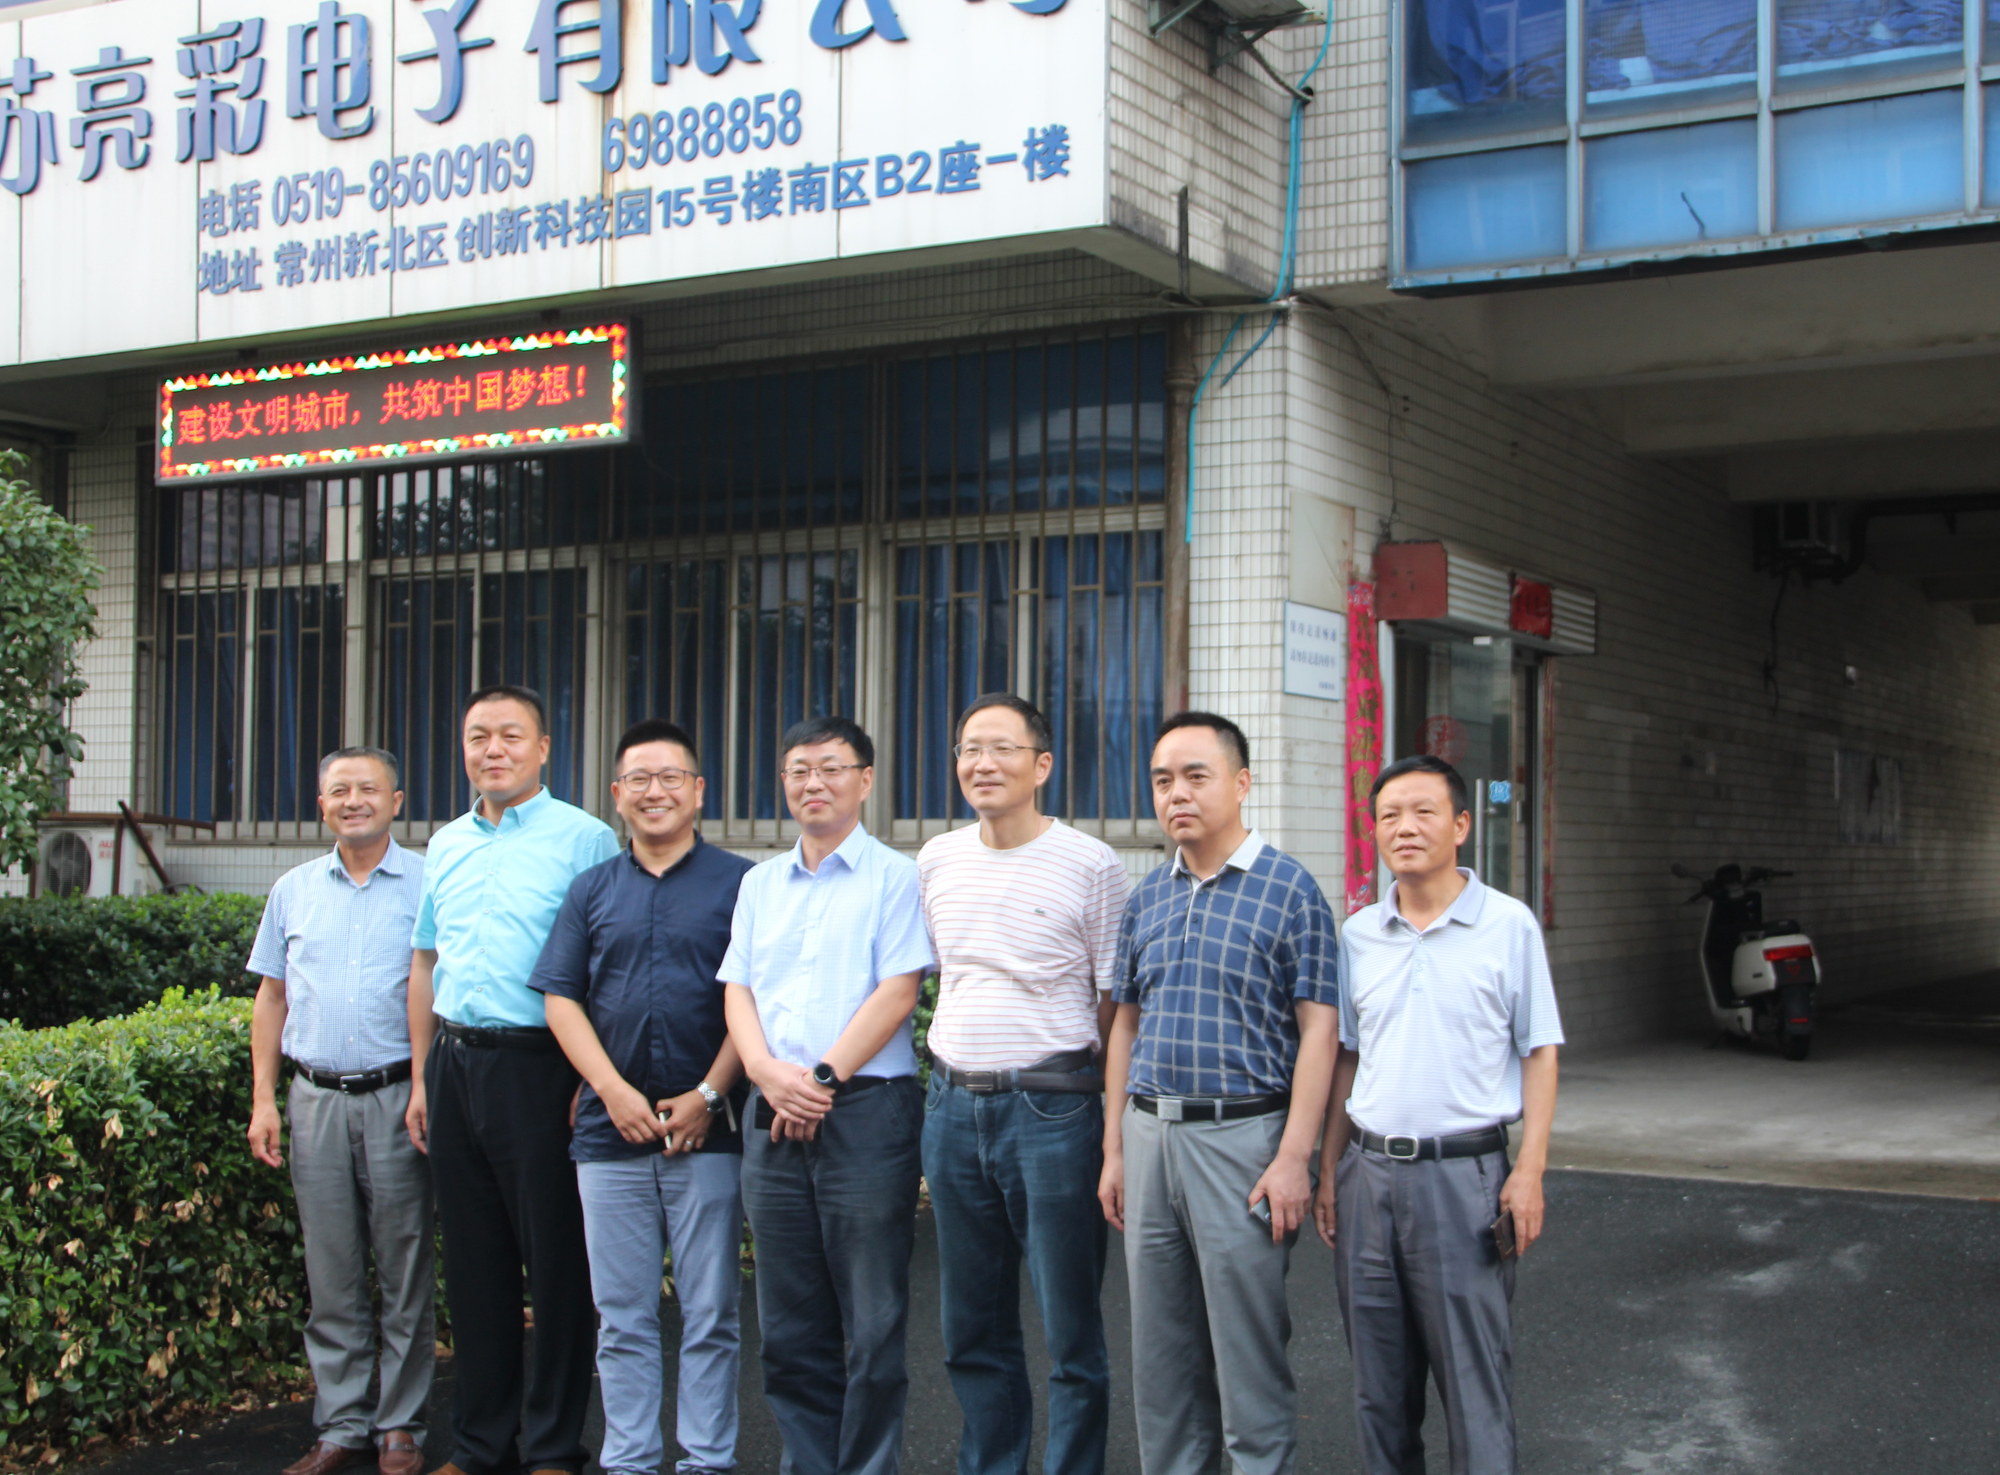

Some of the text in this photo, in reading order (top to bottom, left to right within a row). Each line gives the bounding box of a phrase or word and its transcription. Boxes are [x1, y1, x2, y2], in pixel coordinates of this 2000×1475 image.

[0, 0, 1068, 195] 苏亮彩电子有限
[199, 88, 802, 237] 电话 0519-85609169 69888858
[199, 248, 263, 295] 地址
